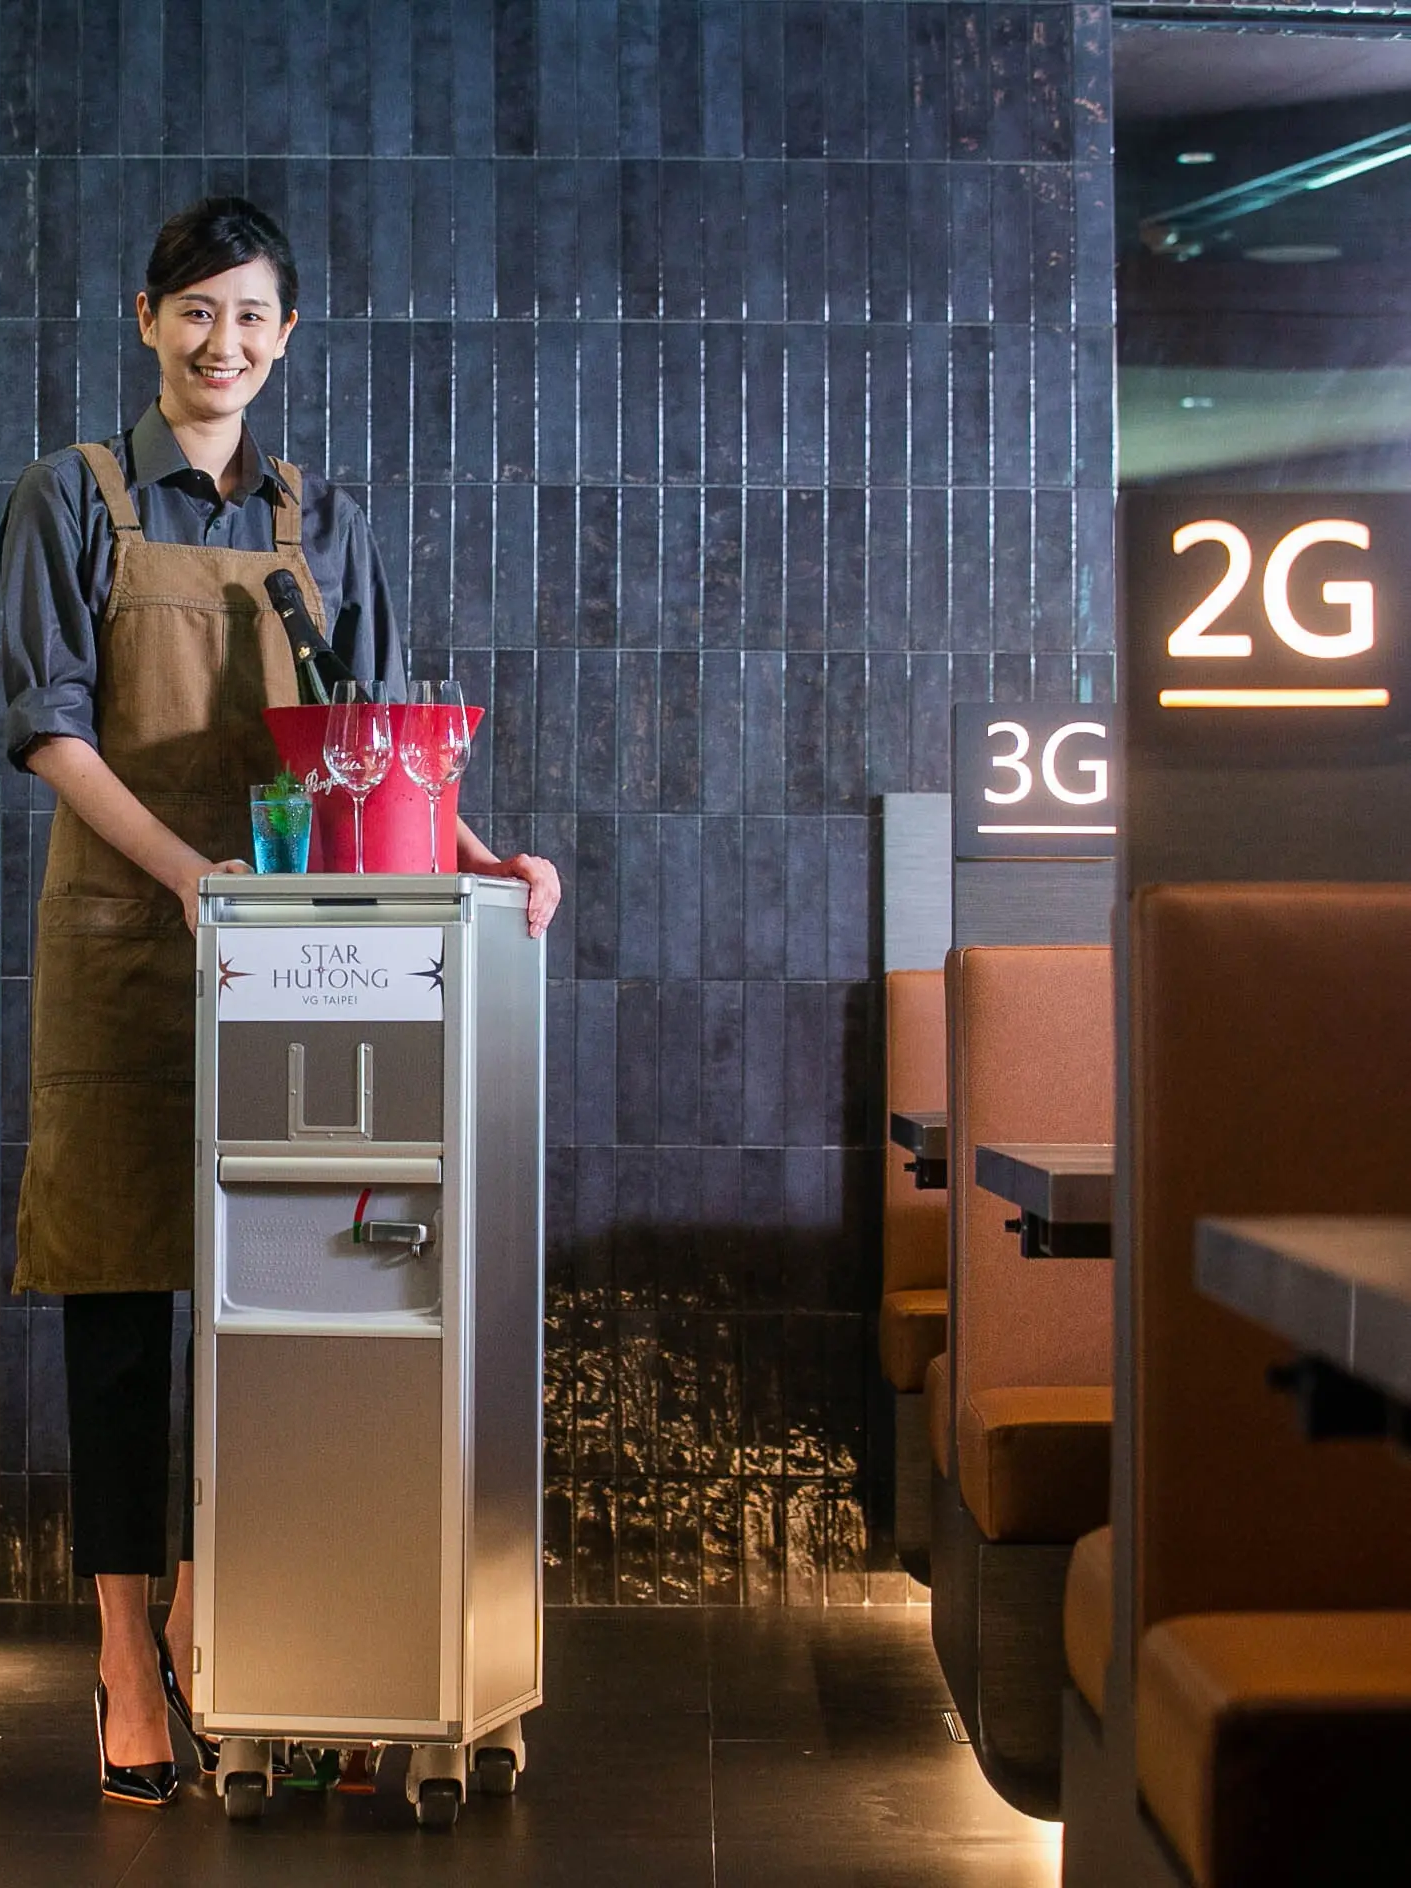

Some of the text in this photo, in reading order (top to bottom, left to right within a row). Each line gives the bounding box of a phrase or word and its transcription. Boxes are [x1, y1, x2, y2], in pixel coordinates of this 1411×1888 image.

[1167, 519, 1374, 659] 2G
[983, 721, 1108, 806] 3G
[300, 944, 362, 966] STAR
[273, 967, 388, 989] HUTONG
[302, 995, 358, 1005] VG TAIPEI
